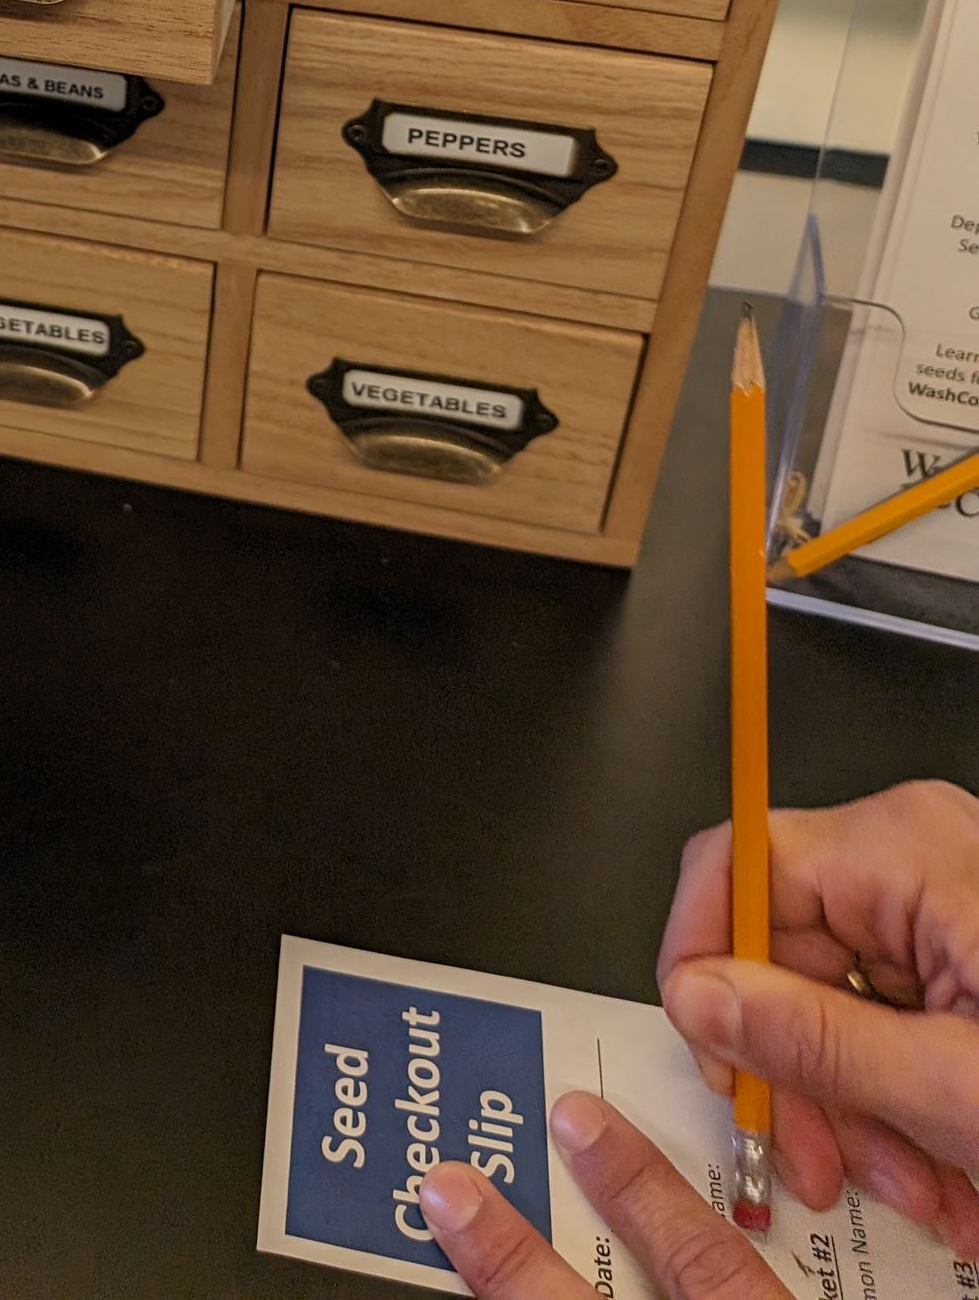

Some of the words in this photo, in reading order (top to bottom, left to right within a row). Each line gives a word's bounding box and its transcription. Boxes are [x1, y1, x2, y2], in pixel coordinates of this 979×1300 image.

[26, 76, 39, 91] &
[44, 79, 104, 99] BEANS
[407, 127, 527, 159] PEPPERS
[915, 363, 966, 383] seeds
[350, 381, 508, 419] VEGETABLES
[321, 1042, 369, 1169] Seed
[467, 1089, 524, 1185] Slip
[707, 1163, 727, 1218] ame:
[846, 1190, 870, 1255] Name:
[593, 1235, 614, 1300] Date:
[809, 1232, 834, 1263] #2
